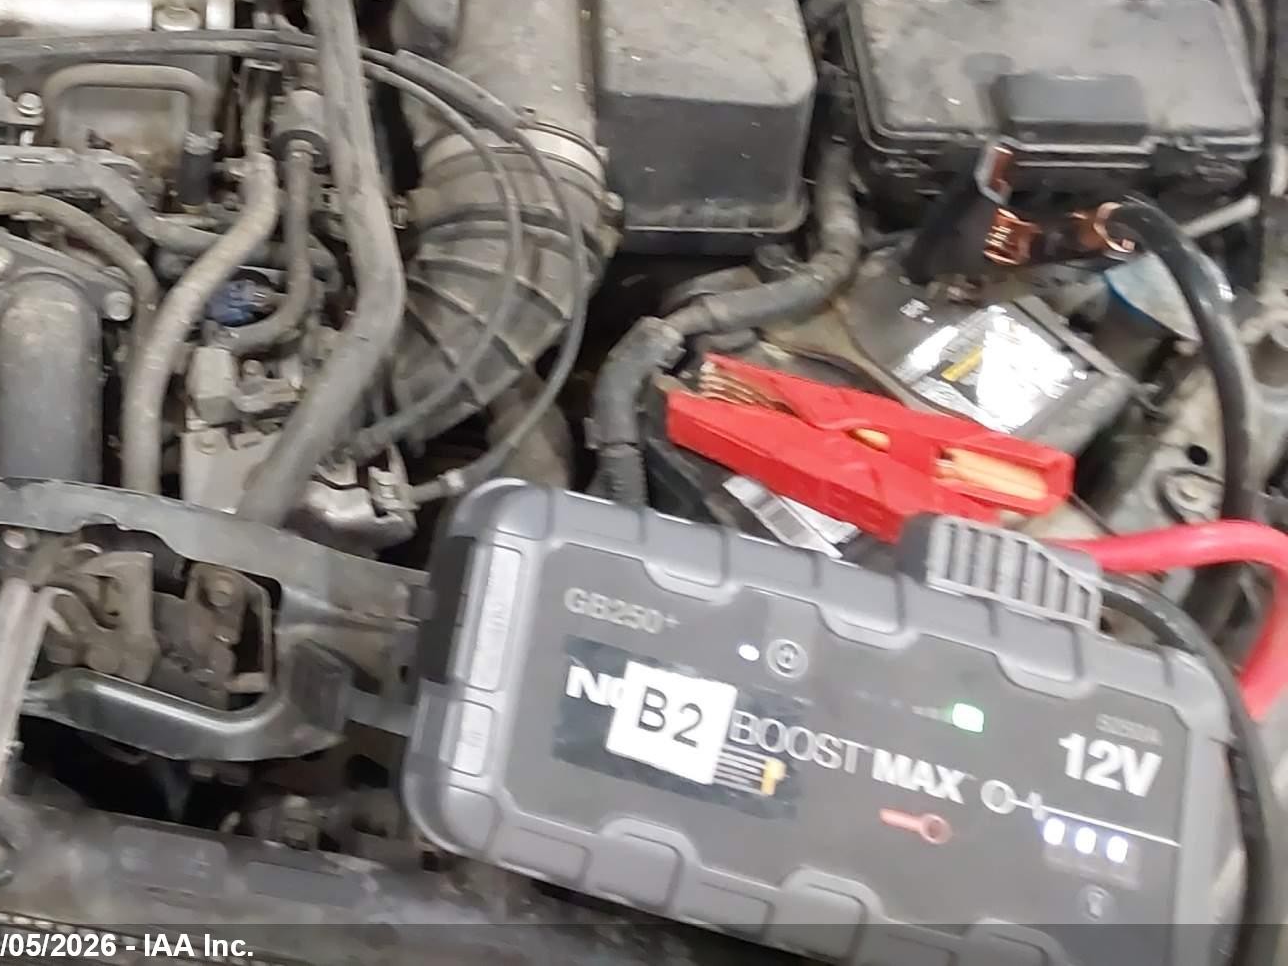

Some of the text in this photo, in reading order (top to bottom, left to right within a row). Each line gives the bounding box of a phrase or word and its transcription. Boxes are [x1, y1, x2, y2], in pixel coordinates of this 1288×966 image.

[637, 686, 703, 748] B2
[729, 709, 966, 804] BOOST MAX
[1058, 732, 1163, 798] 12V
